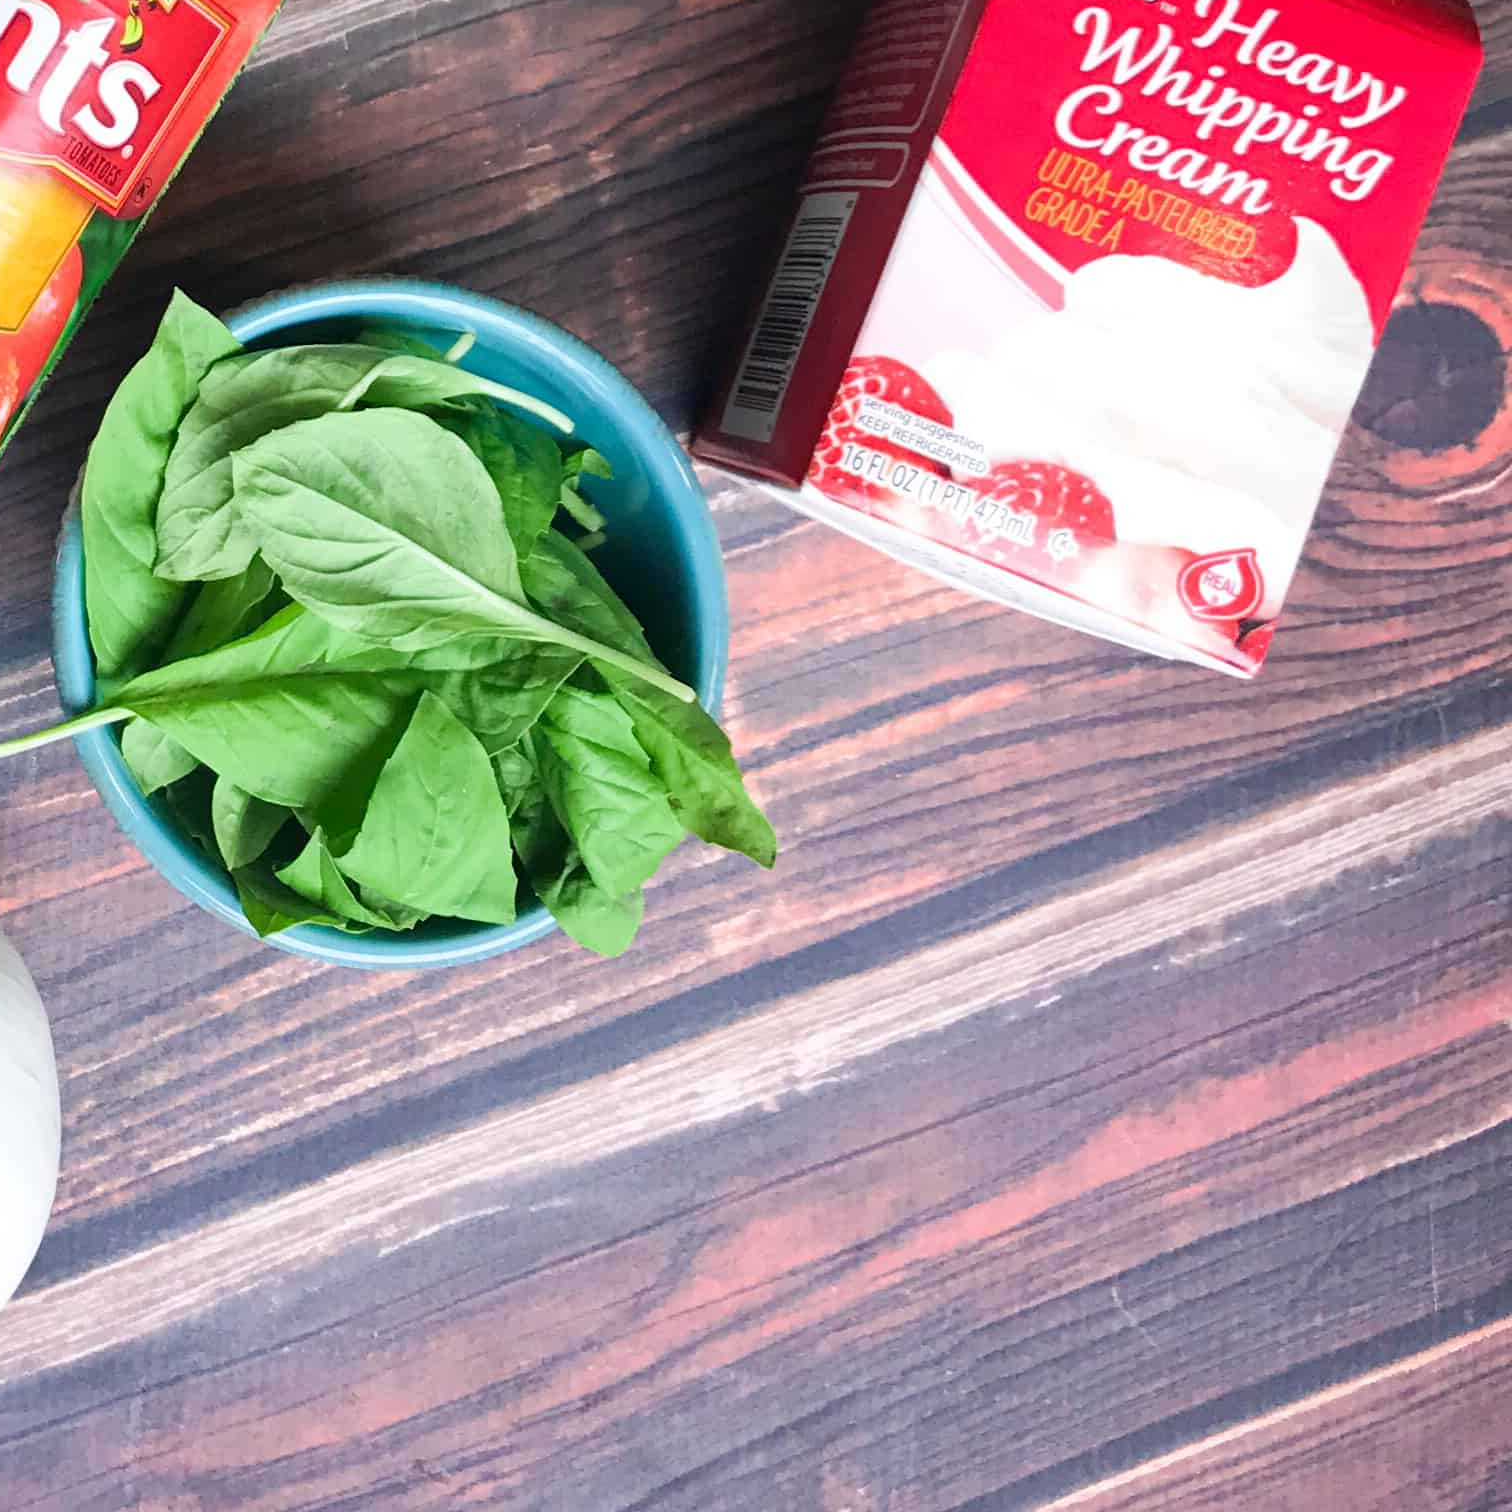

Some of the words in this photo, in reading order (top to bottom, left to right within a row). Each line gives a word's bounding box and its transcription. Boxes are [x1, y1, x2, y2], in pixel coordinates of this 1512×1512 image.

[1073, 7, 1393, 202] Whipping
[61, 135, 124, 188] TOMATOES
[1054, 84, 1273, 215] Cream
[1025, 186, 1103, 246] GRADE
[1099, 218, 1125, 252] A
[1037, 147, 1257, 260] ULTRA-PASTEURIZED
[856, 413, 891, 434] KEEP
[891, 423, 987, 475] REFRIGERATED
[864, 395, 912, 426] serving
[914, 414, 986, 454] suggestion
[842, 444, 866, 472] 16
[866, 453, 888, 483] FL
[891, 463, 920, 494] OZ
[919, 478, 940, 503] (1
[942, 484, 973, 515] PT)
[973, 495, 1037, 542] 473mL
